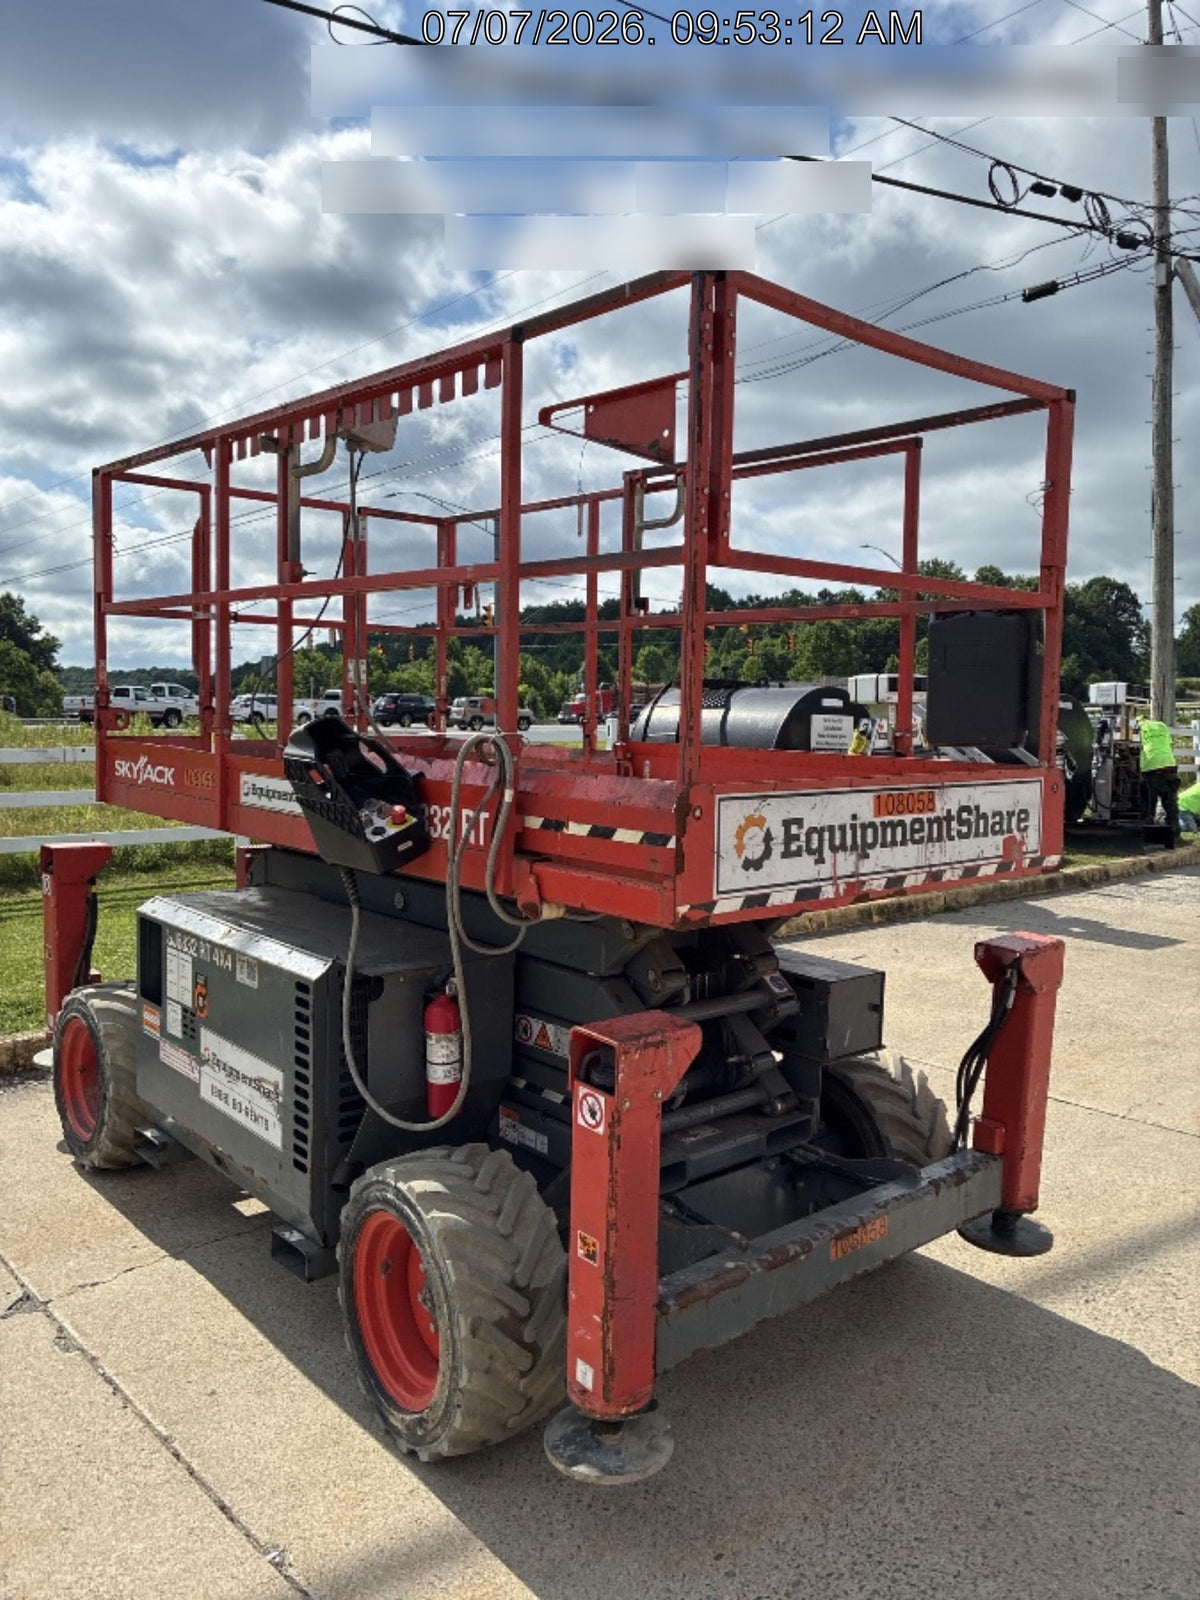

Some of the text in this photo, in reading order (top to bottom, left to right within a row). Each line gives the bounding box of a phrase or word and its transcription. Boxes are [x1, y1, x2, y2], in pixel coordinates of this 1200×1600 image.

[114, 755, 175, 785] SKYJACK
[875, 791, 936, 816] 108058
[461, 808, 490, 846] RT
[780, 804, 1030, 865] EquipmentShare
